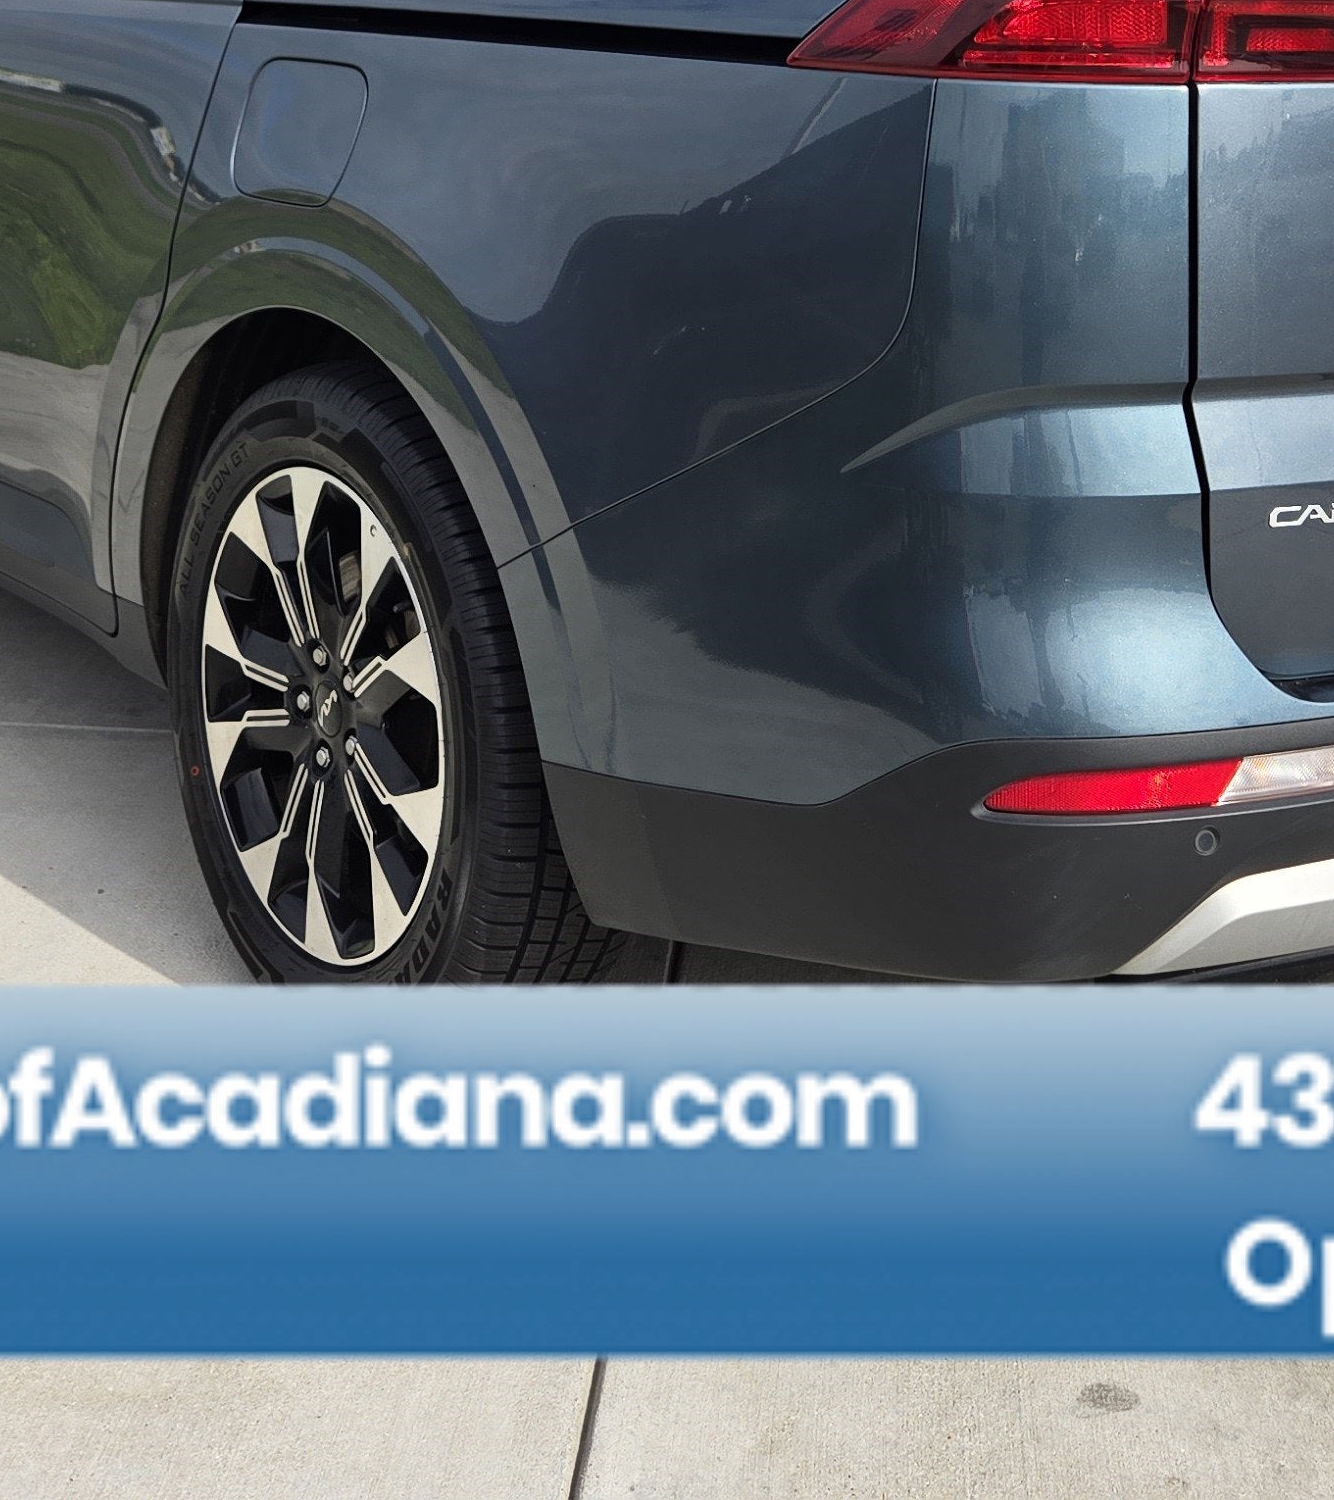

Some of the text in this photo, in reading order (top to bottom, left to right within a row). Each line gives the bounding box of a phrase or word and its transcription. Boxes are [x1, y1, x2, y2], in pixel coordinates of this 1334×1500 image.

[179, 442, 251, 599] ALL SEASON GT
